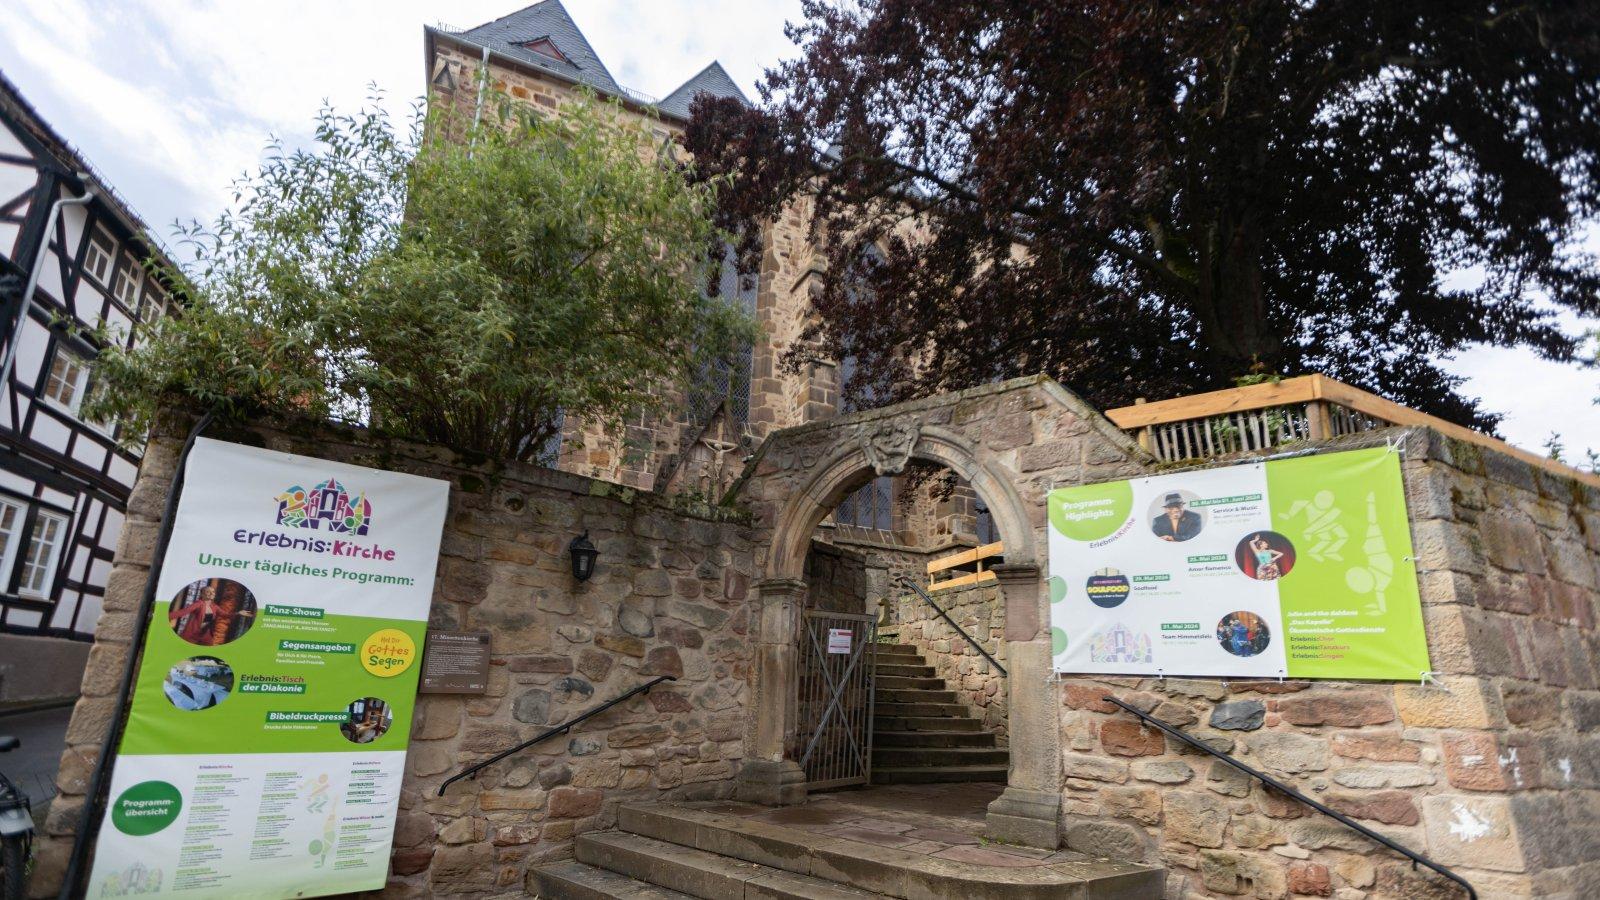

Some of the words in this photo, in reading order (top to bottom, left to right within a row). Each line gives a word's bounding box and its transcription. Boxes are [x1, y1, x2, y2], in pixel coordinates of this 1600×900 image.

[1063, 498, 1115, 510] Programm-
[1212, 506, 1234, 514] Service
[1065, 510, 1114, 521] Highlights
[1089, 517, 1136, 549] Erlebnis:Kirche
[233, 529, 396, 561] Erlebnis:Kirche
[198, 553, 251, 571] Unser
[254, 560, 328, 578] tägliches
[331, 567, 415, 586] Programm:
[1087, 585, 1130, 594] SOULFOOD
[268, 606, 322, 617] Tanz-Shows
[282, 641, 352, 652] Segensangebot
[368, 645, 409, 655] Gottes
[369, 655, 404, 669] Segen
[240, 674, 304, 683] Erlebnis:Tisch
[242, 683, 260, 692] der
[261, 684, 303, 693] Diakonie
[269, 712, 347, 722] Bibeldruckpresse
[122, 799, 174, 808] Programm-
[125, 807, 168, 817] übersicht
